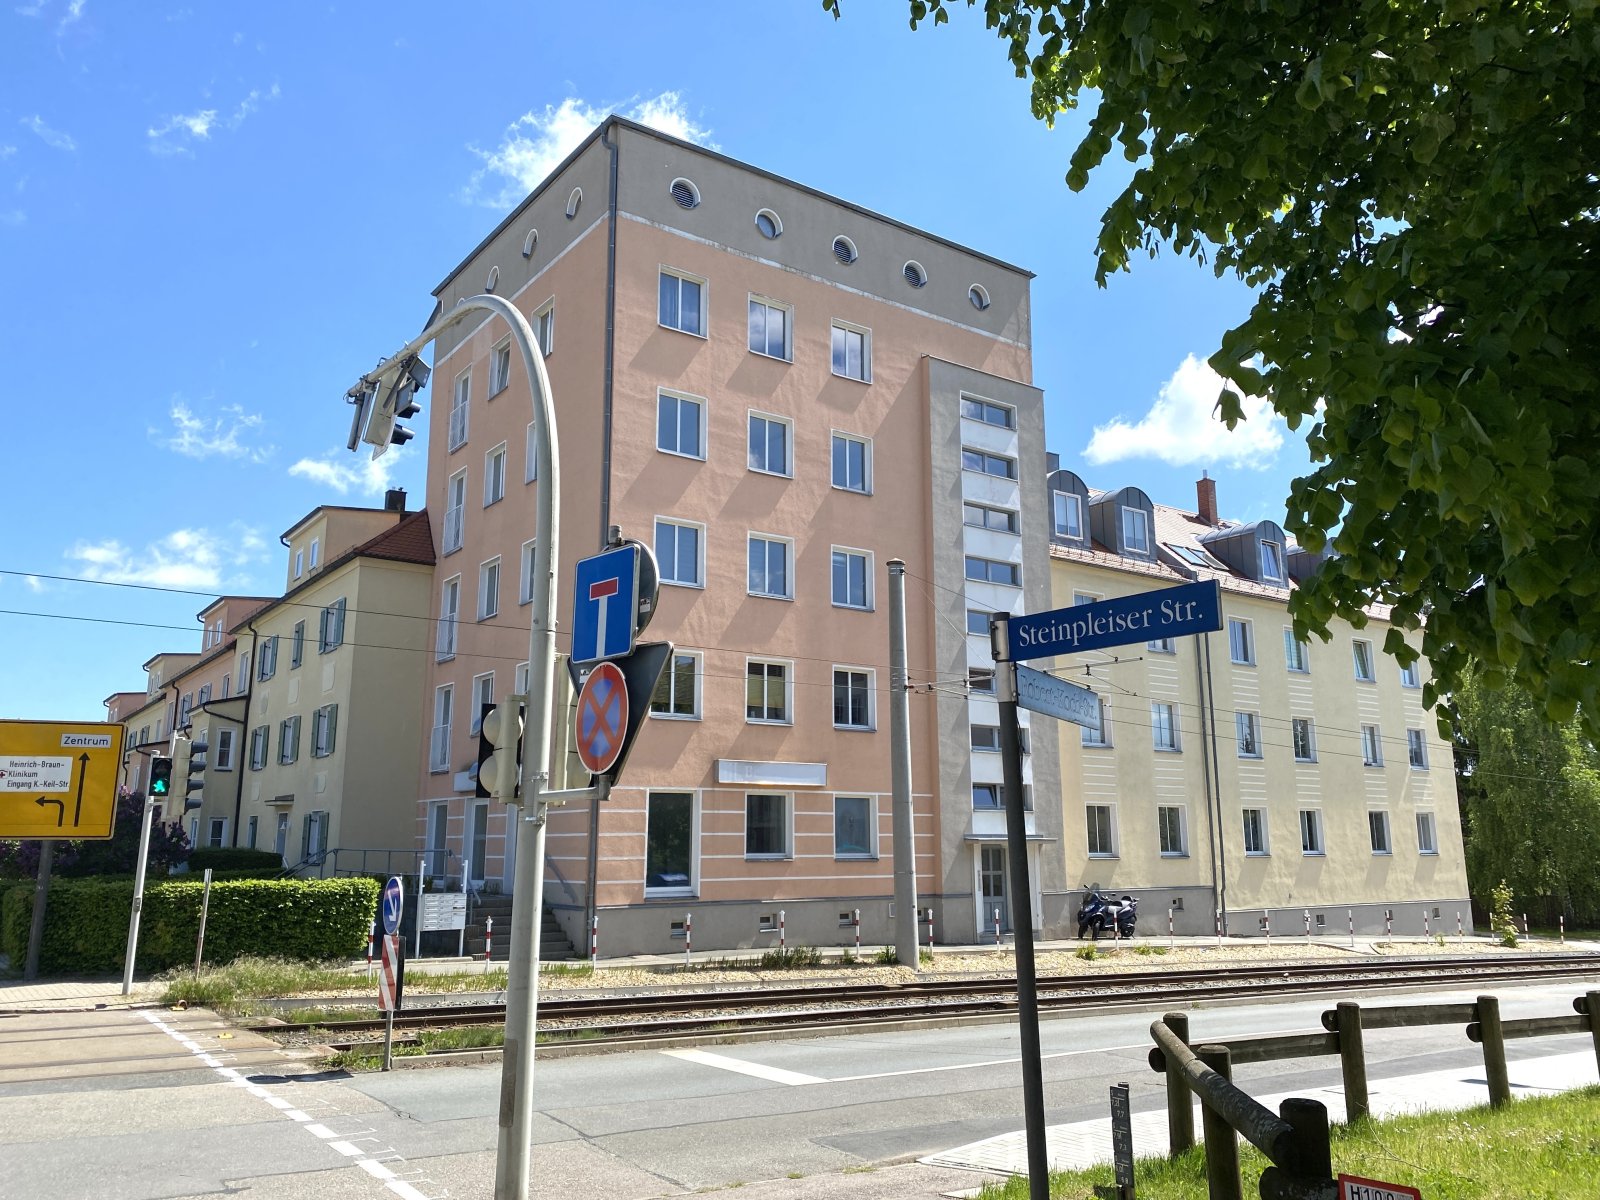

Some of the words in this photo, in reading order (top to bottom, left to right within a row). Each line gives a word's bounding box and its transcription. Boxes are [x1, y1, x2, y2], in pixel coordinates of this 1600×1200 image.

[1019, 602, 1152, 646] Steinpleiser
[1161, 599, 1203, 624] Str.
[64, 736, 109, 745] Zentrum
[9, 760, 65, 768] Heinrich-Braun-
[7, 780, 32, 788] Eingang
